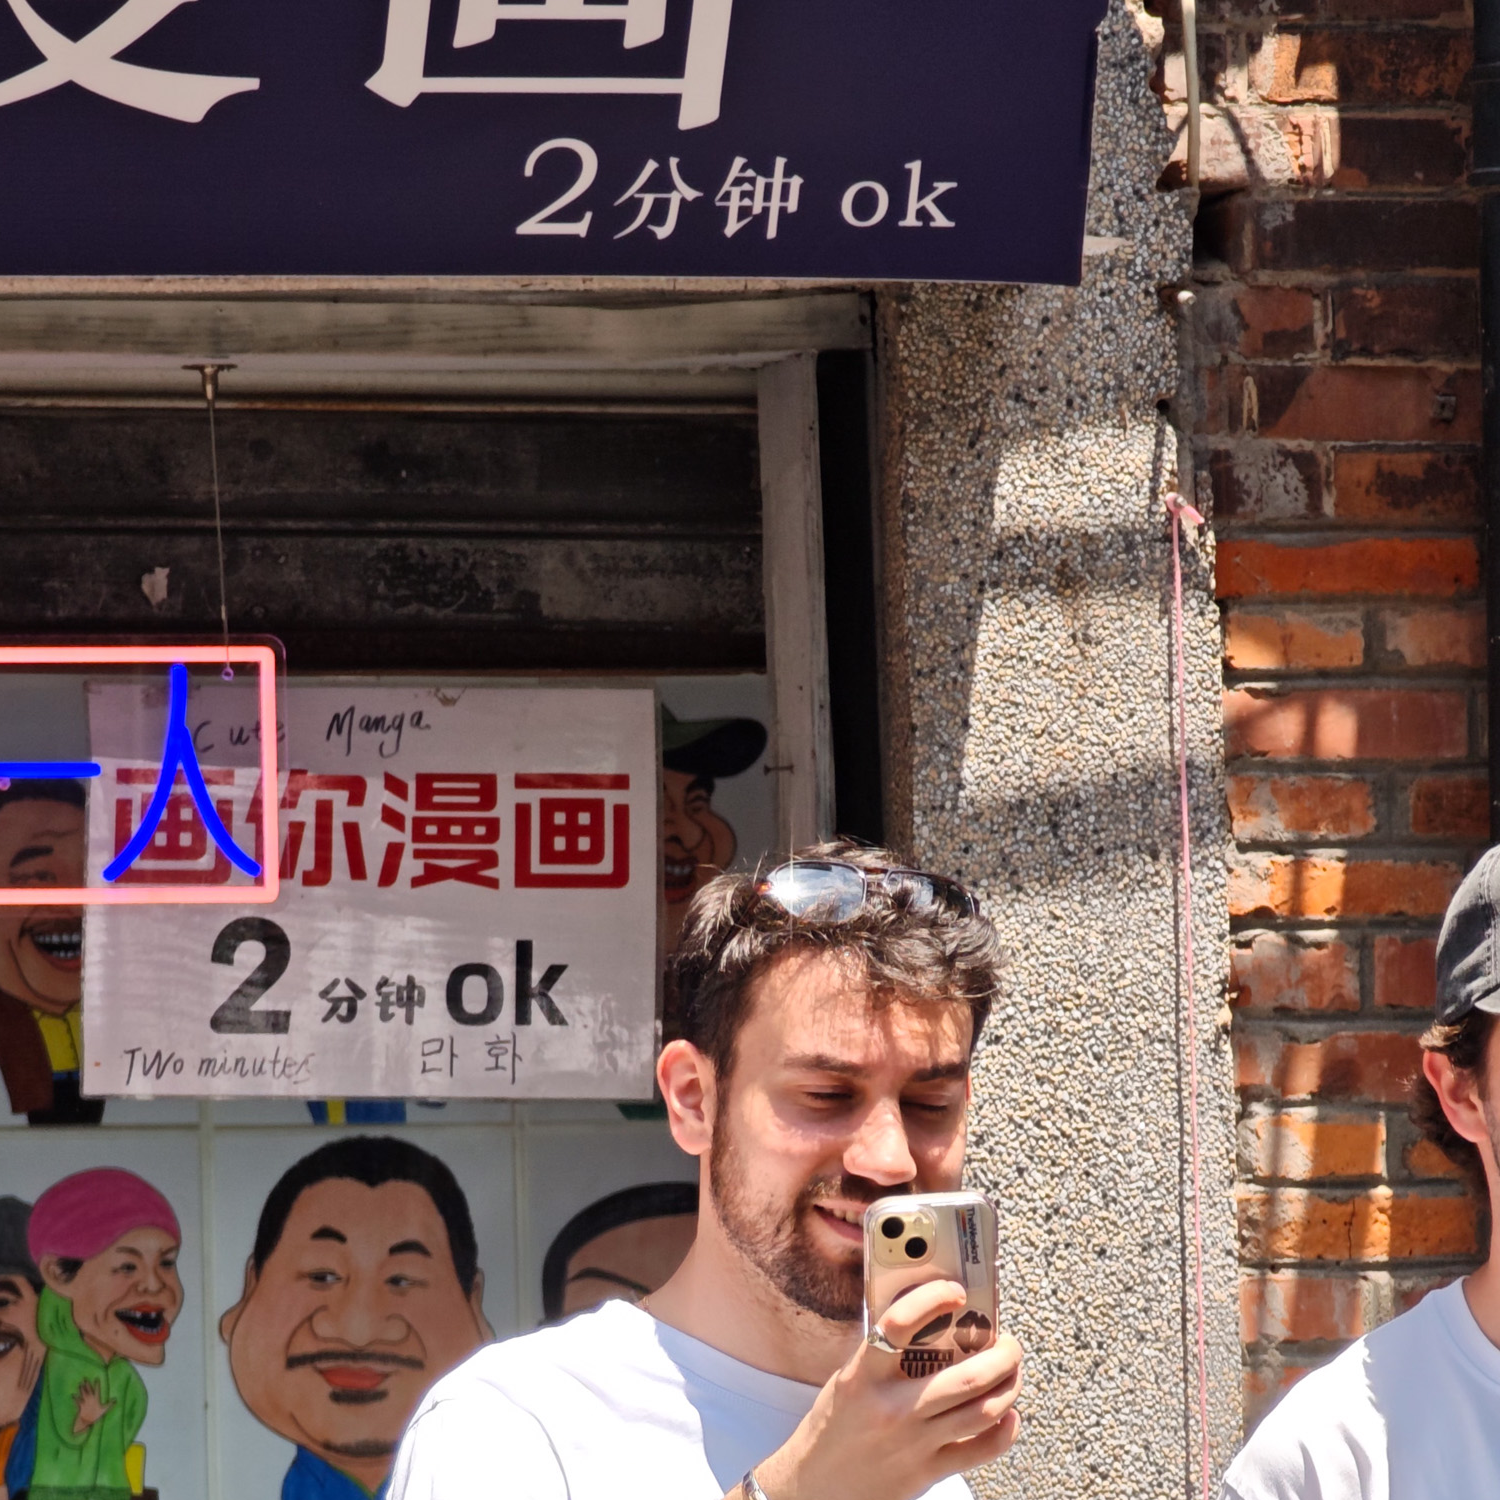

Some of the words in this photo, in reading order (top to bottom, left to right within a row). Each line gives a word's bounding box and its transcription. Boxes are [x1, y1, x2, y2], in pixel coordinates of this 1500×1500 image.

[842, 160, 957, 228] ok
[325, 704, 432, 759] Manga
[113, 767, 631, 890] 画你漫画
[444, 939, 570, 1027] ok
